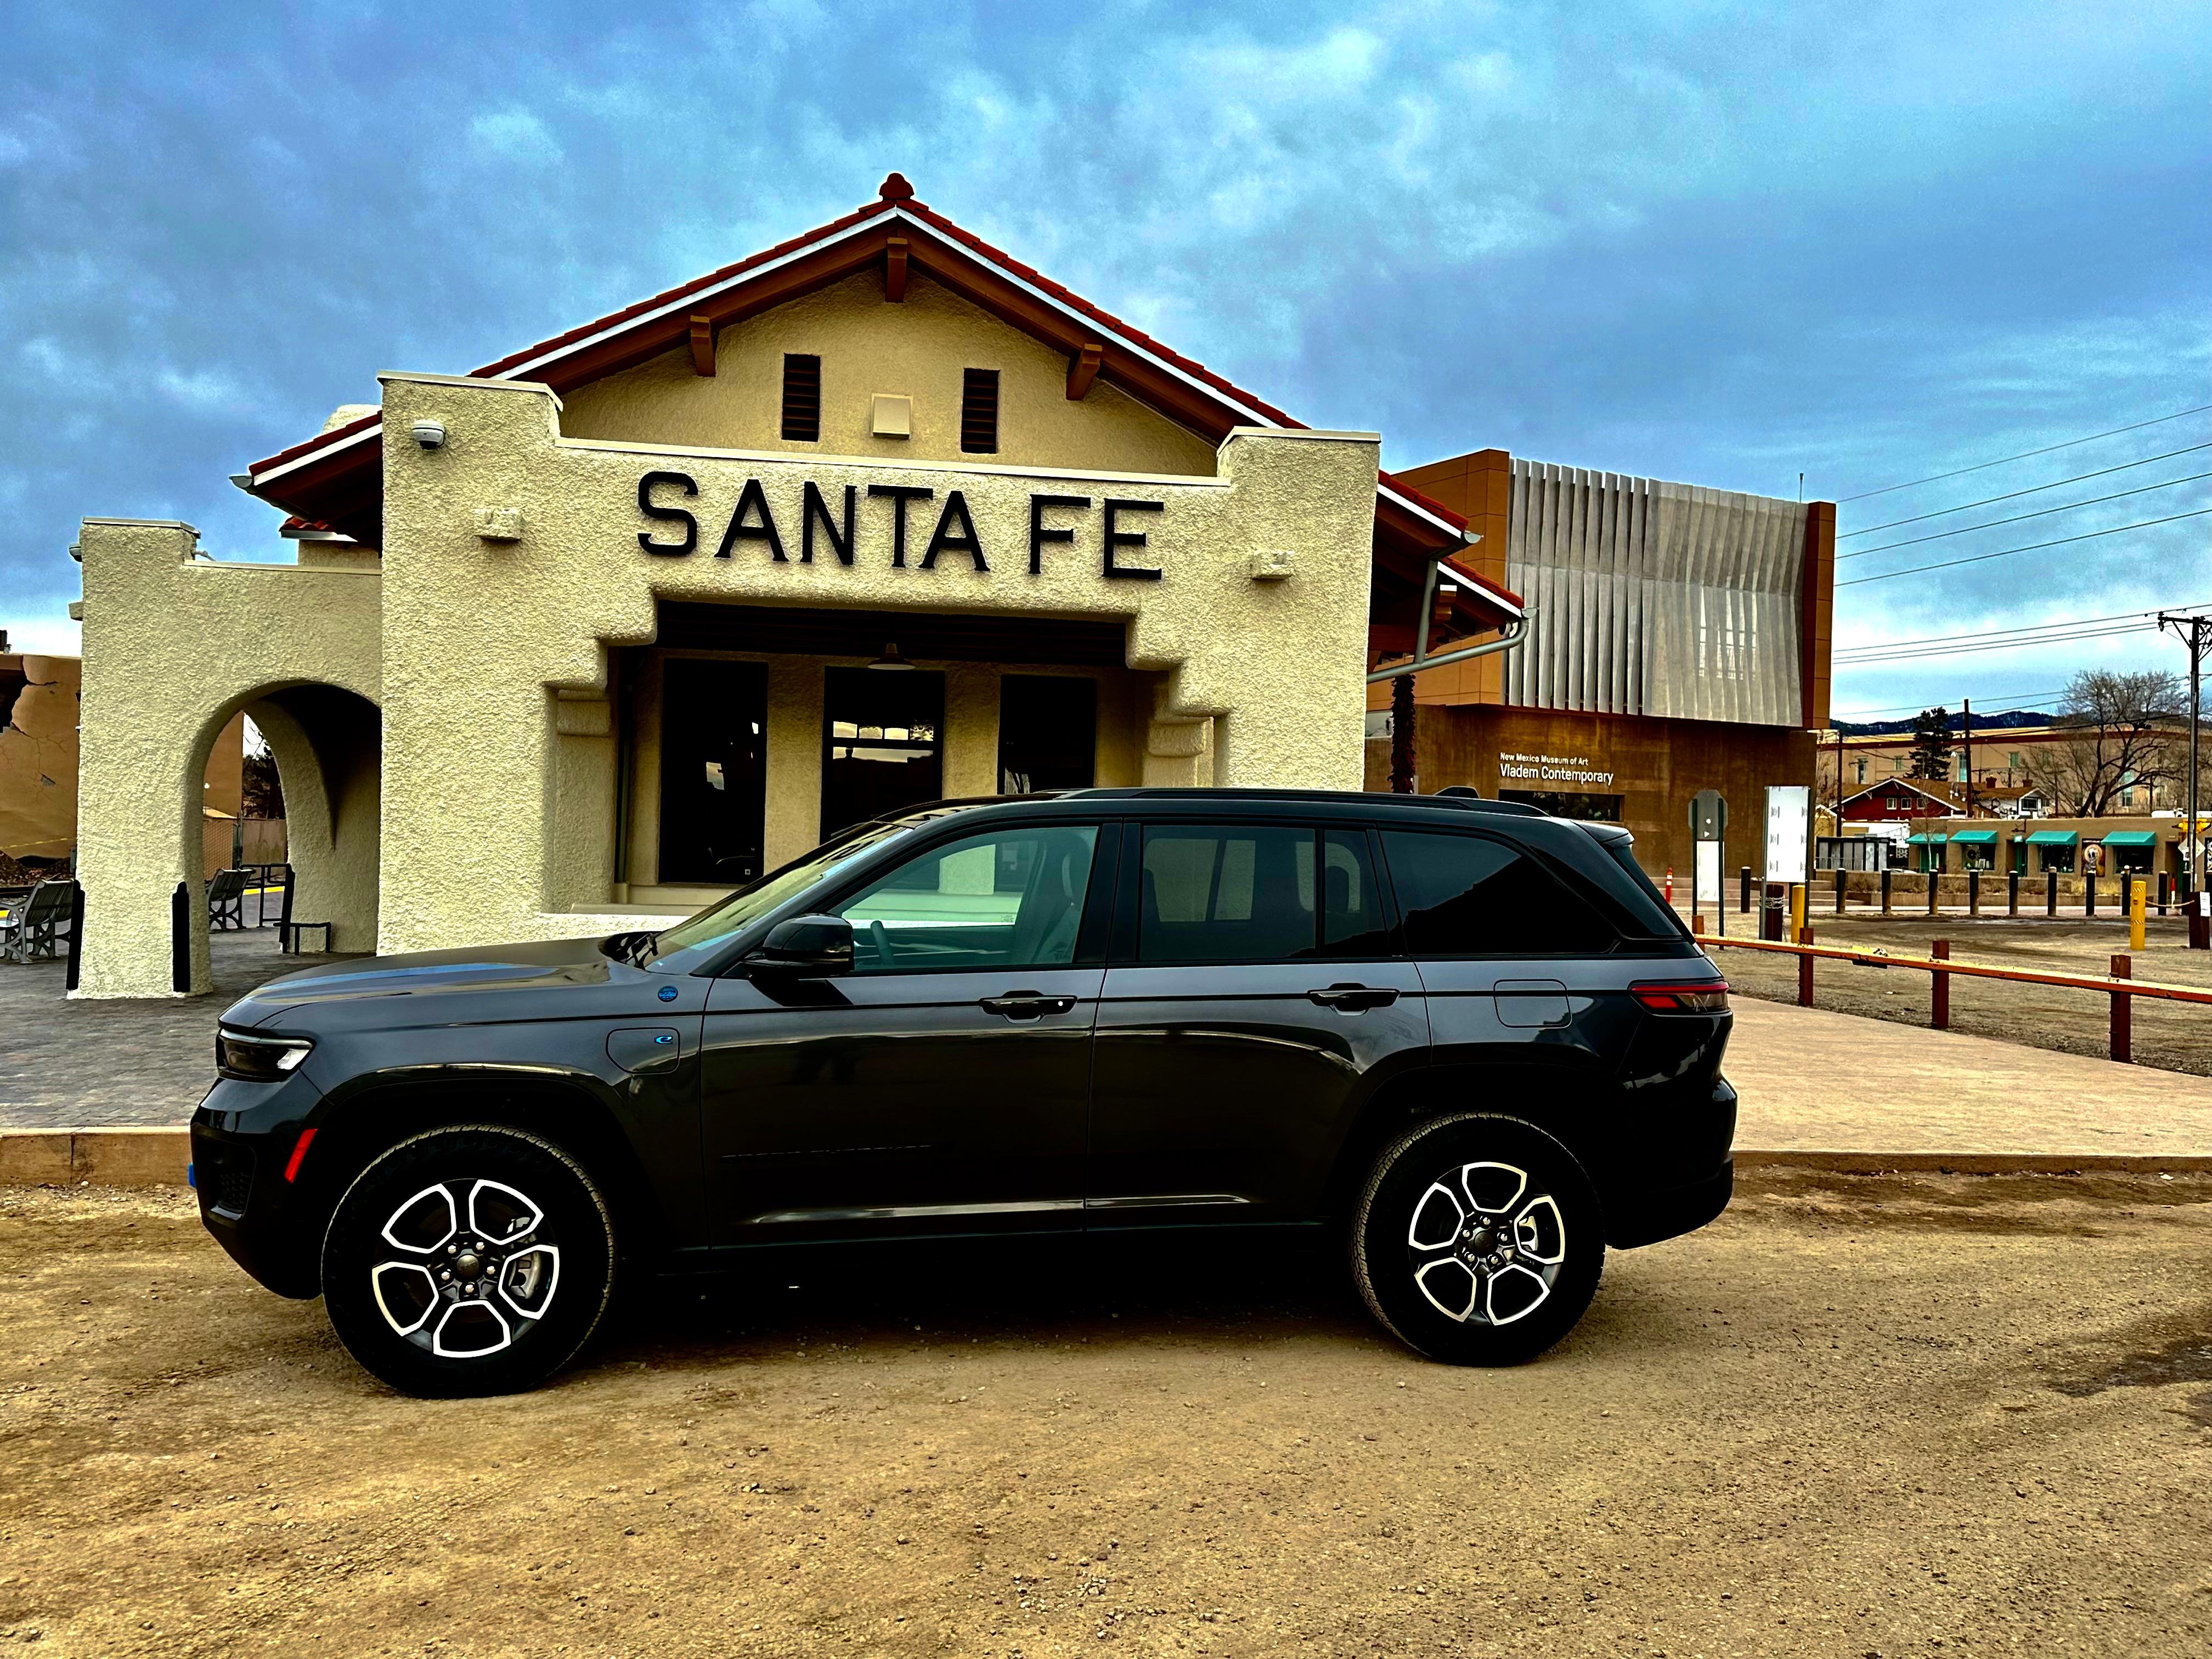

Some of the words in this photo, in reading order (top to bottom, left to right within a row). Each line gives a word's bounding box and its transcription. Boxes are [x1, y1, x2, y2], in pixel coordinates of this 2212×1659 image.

[637, 471, 990, 572] SANTA
[1028, 494, 1164, 580] FE
[1516, 753, 1539, 763] Mexico
[1541, 755, 1568, 765] Museum
[1578, 758, 1589, 766] Art
[1500, 763, 1539, 779] Vladem
[1541, 766, 1614, 786] Contemporary
